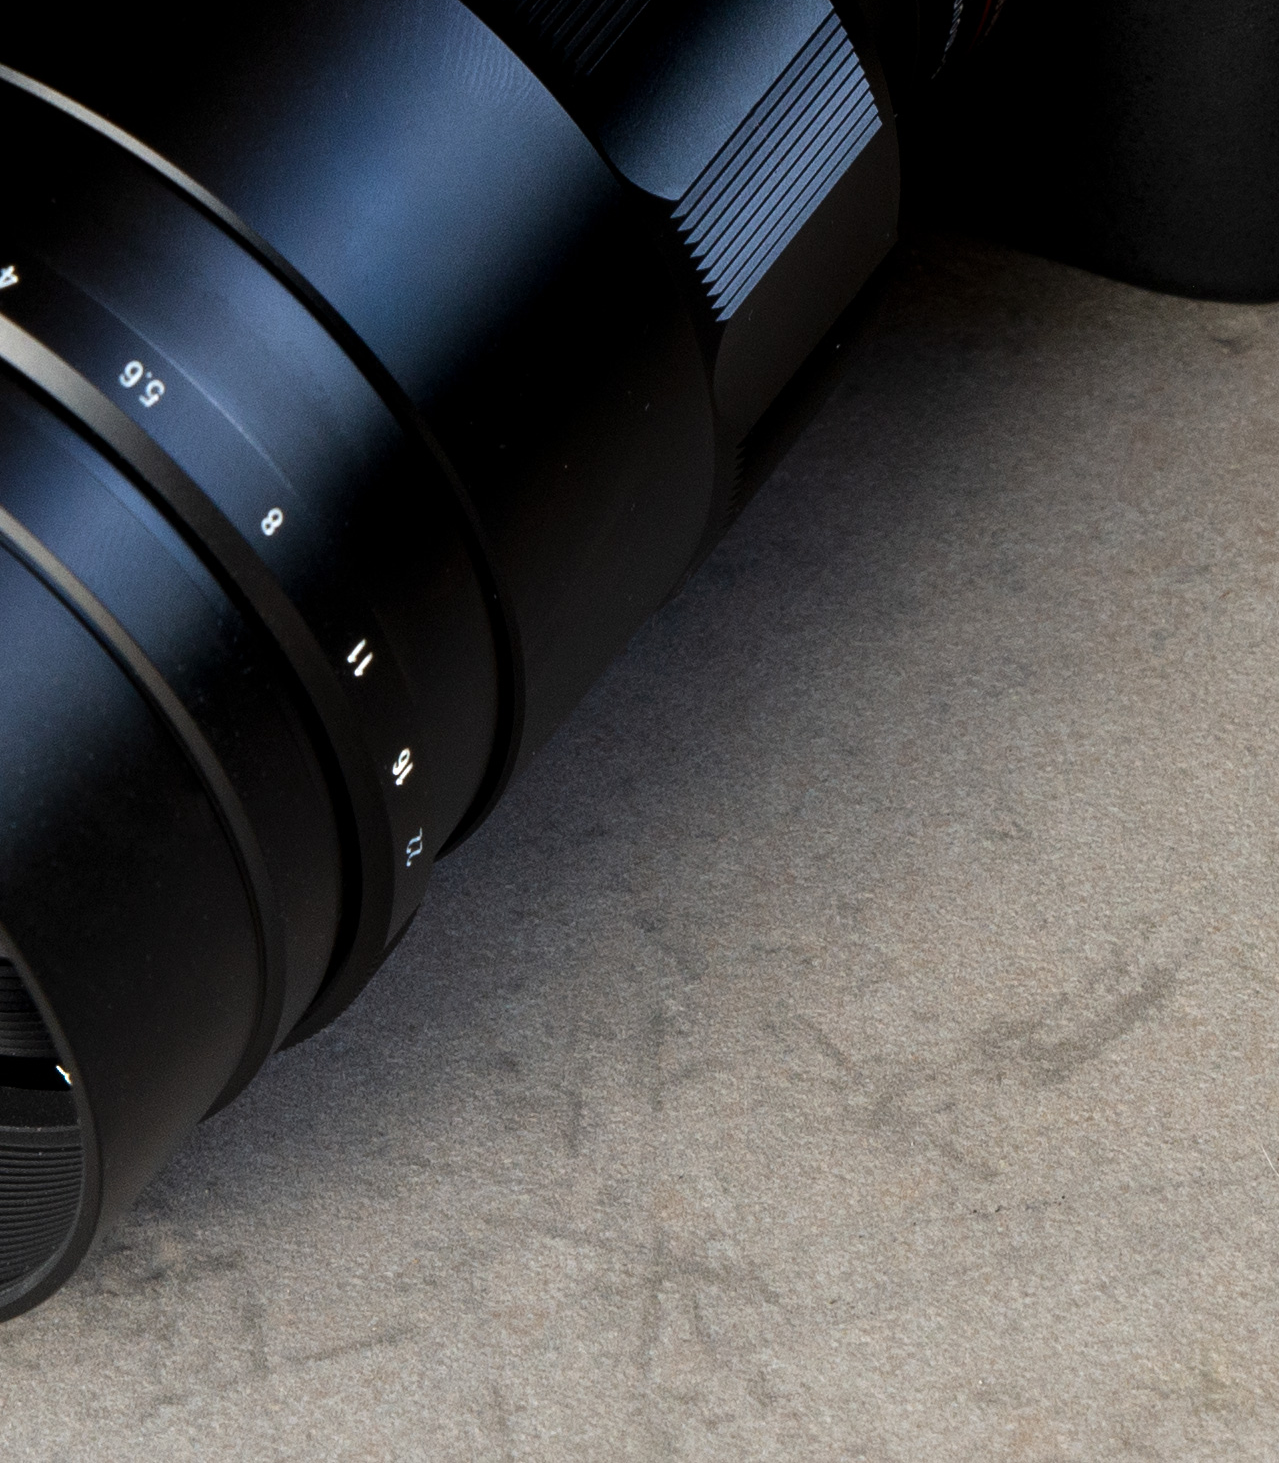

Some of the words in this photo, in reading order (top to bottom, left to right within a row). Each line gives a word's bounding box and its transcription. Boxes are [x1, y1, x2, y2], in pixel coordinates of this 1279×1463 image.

[119, 361, 165, 407] 5.6
[261, 507, 283, 536] 8
[347, 639, 372, 676] 11
